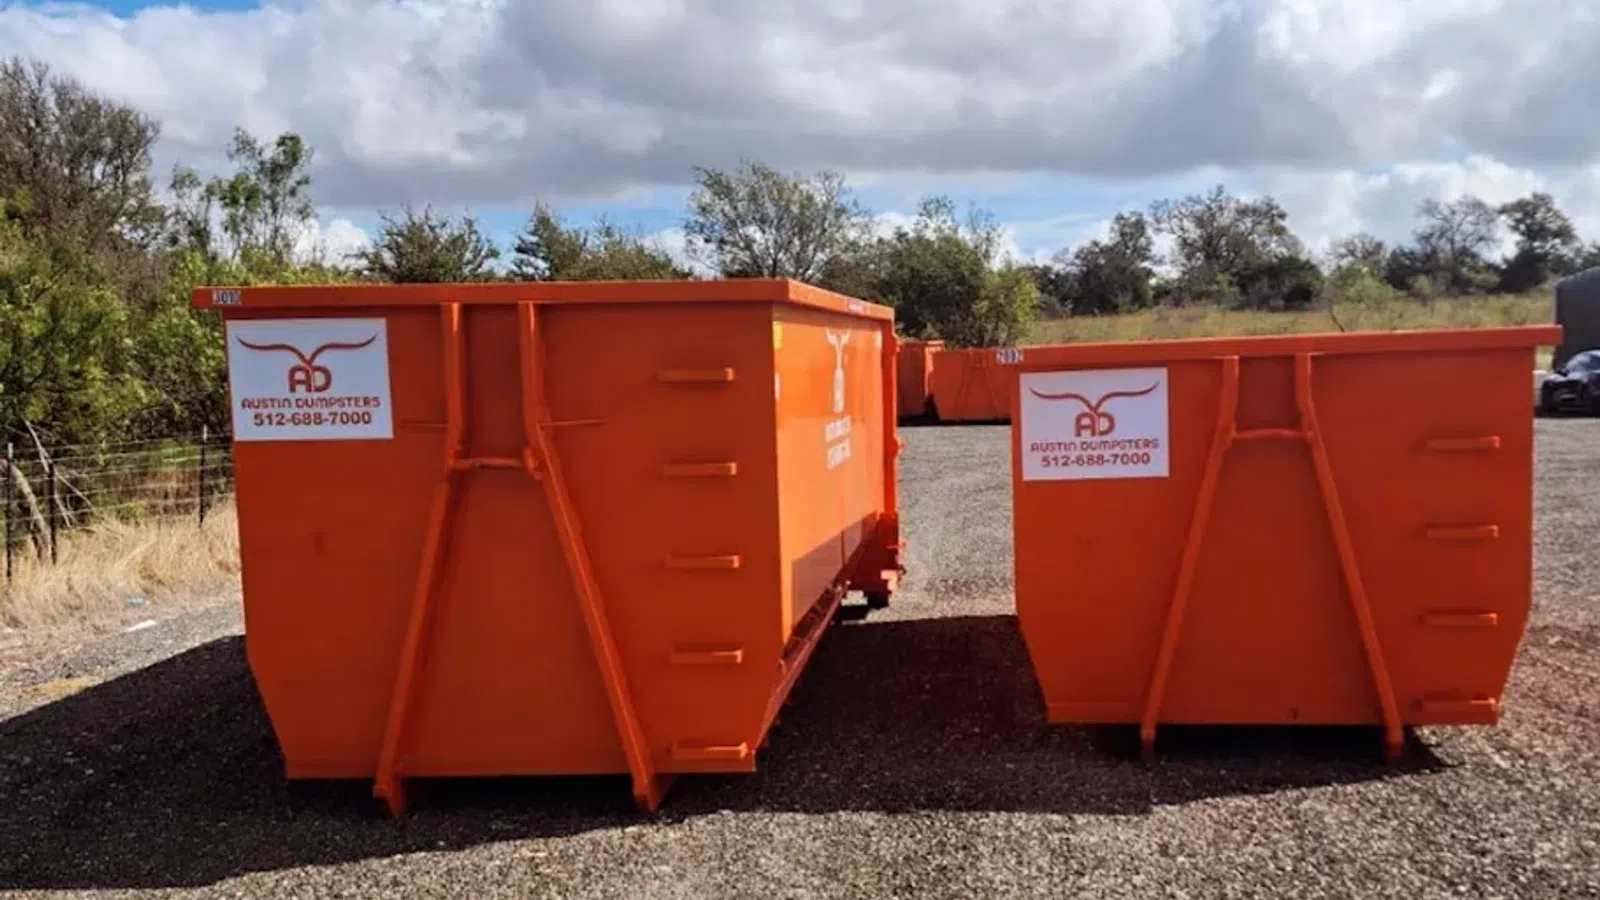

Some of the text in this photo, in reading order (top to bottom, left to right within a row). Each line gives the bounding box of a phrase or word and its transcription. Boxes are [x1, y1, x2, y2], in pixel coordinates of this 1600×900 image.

[288, 365, 332, 393] AD
[241, 396, 381, 410] AUSTIN DUMPSTERS
[253, 411, 372, 427] 512-688-7000
[1075, 412, 1115, 437] AD
[1031, 438, 1160, 453] AUSTIN DUMPSTERS
[1041, 453, 1151, 467] 512-688-7000
